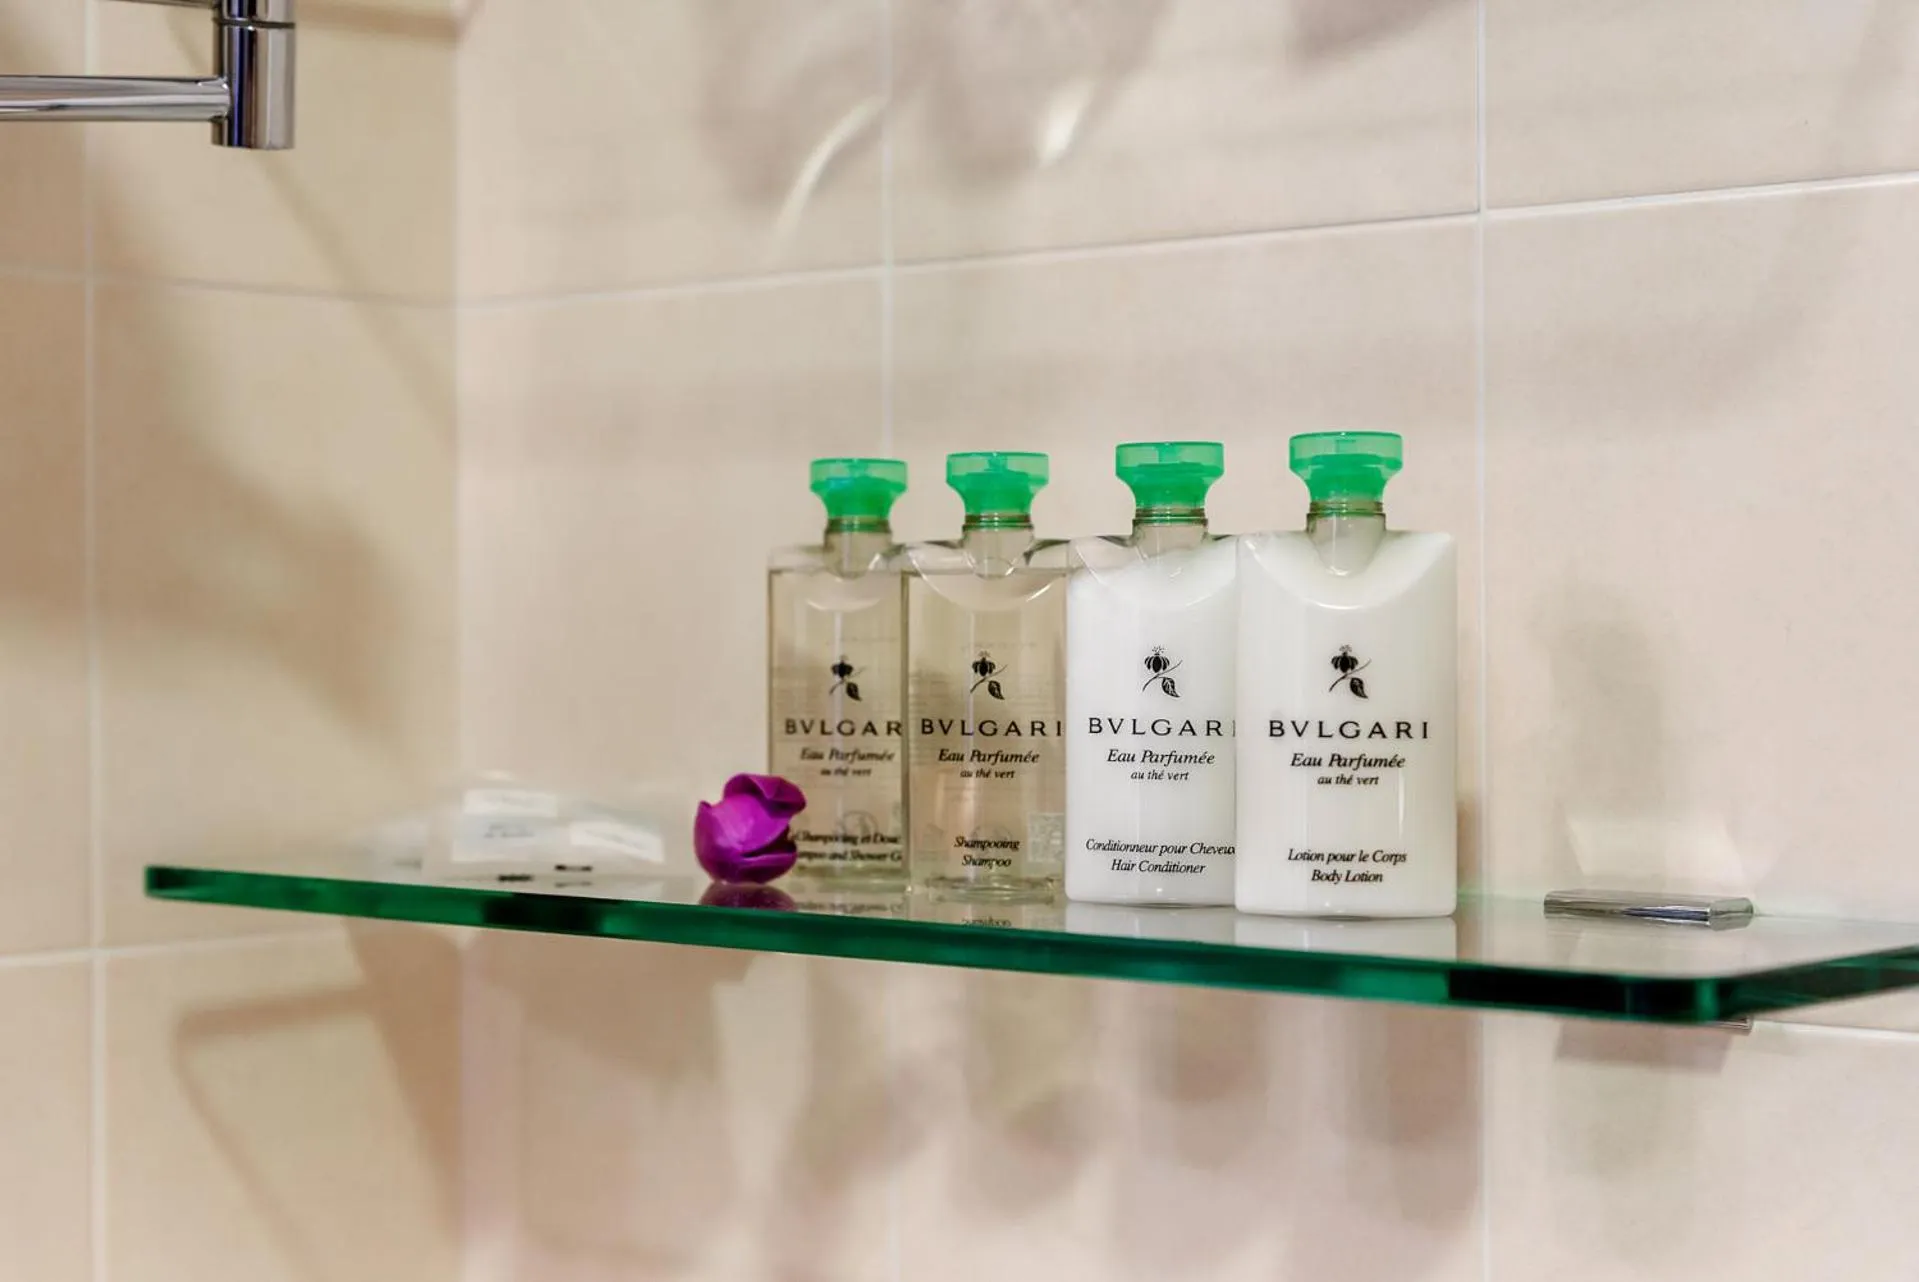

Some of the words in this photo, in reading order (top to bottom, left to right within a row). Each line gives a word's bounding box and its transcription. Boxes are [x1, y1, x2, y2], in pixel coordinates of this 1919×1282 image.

[785, 718, 902, 736] BVLGAR
[920, 717, 1063, 737] BVLGARI
[1088, 717, 1236, 738] BVLGARI
[1268, 719, 1429, 739] BVLGARI
[800, 747, 824, 760] Eau
[938, 748, 965, 762] Eau
[969, 749, 1040, 766] Parfumée
[1107, 748, 1136, 762] Eau
[1139, 749, 1215, 767] Parfumée
[1290, 753, 1322, 767] Eau
[1328, 753, 1406, 771] Parfumée
[960, 769, 973, 779] au
[975, 767, 991, 779] thé
[994, 769, 1016, 779] vert
[1130, 770, 1145, 781] au
[1147, 769, 1165, 781] thé
[1167, 770, 1190, 781] vert
[1317, 774, 1332, 786] au
[1335, 773, 1354, 786] thé
[1356, 774, 1380, 786] vert
[953, 835, 1020, 852] Shampooing
[1085, 838, 1158, 853] Conditionneur
[1158, 844, 1188, 856] pour
[961, 854, 1012, 869] Shampoo
[1287, 848, 1325, 862] Lotion
[1326, 852, 1356, 865] pour
[1358, 850, 1370, 863] le
[1371, 850, 1408, 866] Corps
[1111, 859, 1136, 872] Hair
[1138, 860, 1206, 874] Conditioner
[1311, 869, 1343, 885] Body
[1344, 870, 1384, 883] Lotion
